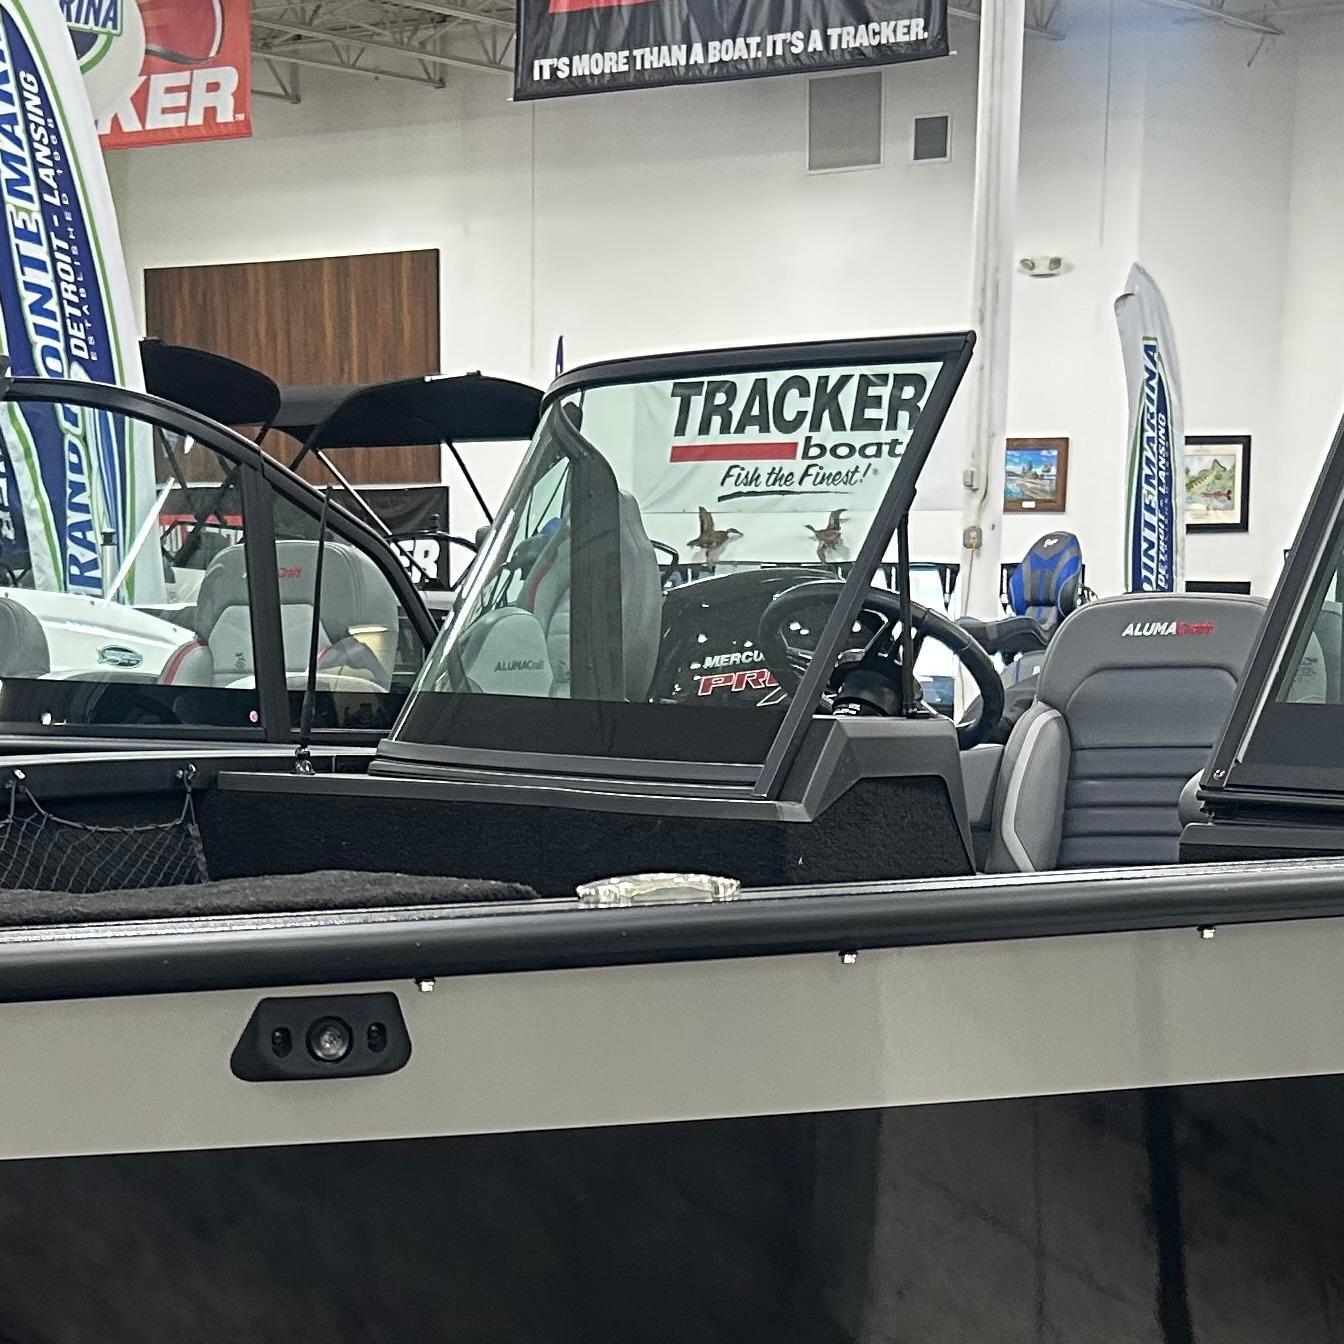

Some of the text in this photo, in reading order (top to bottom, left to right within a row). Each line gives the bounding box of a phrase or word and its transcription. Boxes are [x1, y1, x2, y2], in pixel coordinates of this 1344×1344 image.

[533, 18, 929, 81] IT'S MORE THAN A BOAT. IT'S A TRACKER.
[17, 70, 62, 207] LANSING
[49, 231, 89, 360] DETROIT
[670, 373, 928, 437] TRACKER
[720, 464, 761, 488] Fish
[765, 466, 795, 488] the
